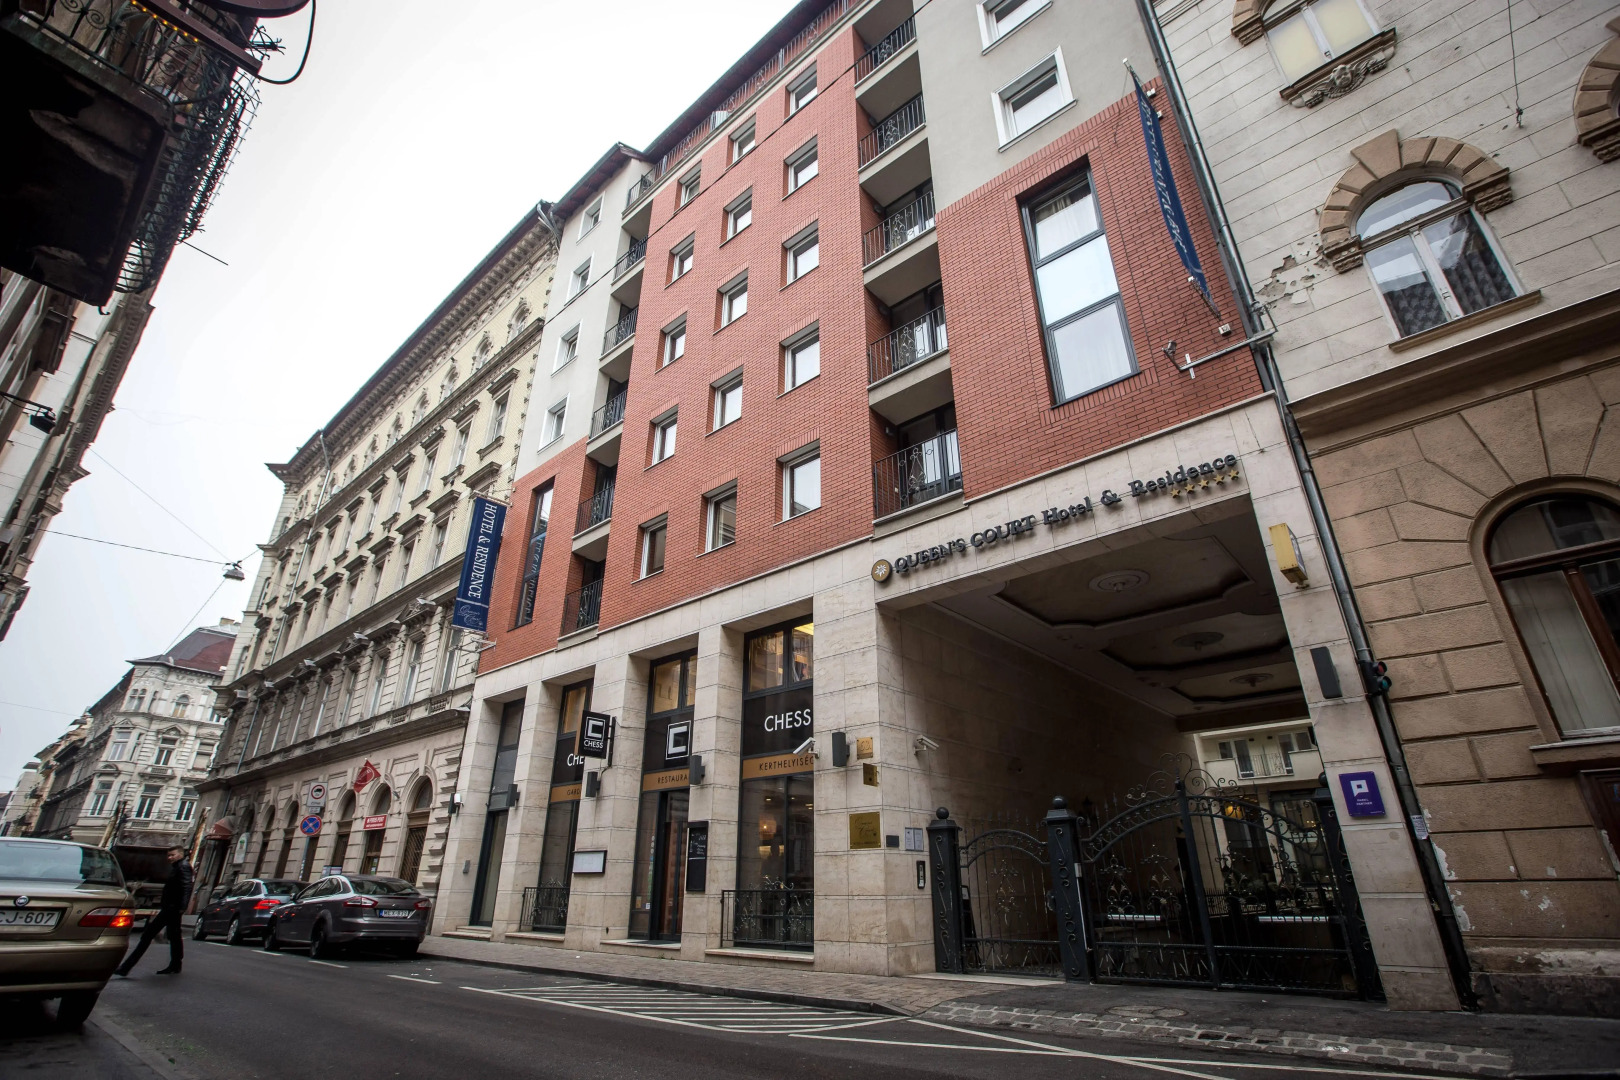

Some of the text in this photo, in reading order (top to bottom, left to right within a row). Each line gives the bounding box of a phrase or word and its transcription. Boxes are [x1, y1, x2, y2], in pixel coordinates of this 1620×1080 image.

[895, 454, 1237, 573] QUEEN'S COURT Hotel & Residence
[468, 503, 498, 599] HOTEL & RESIDENCE
[583, 740, 604, 749] CHESS
[764, 708, 812, 732] CHESS
